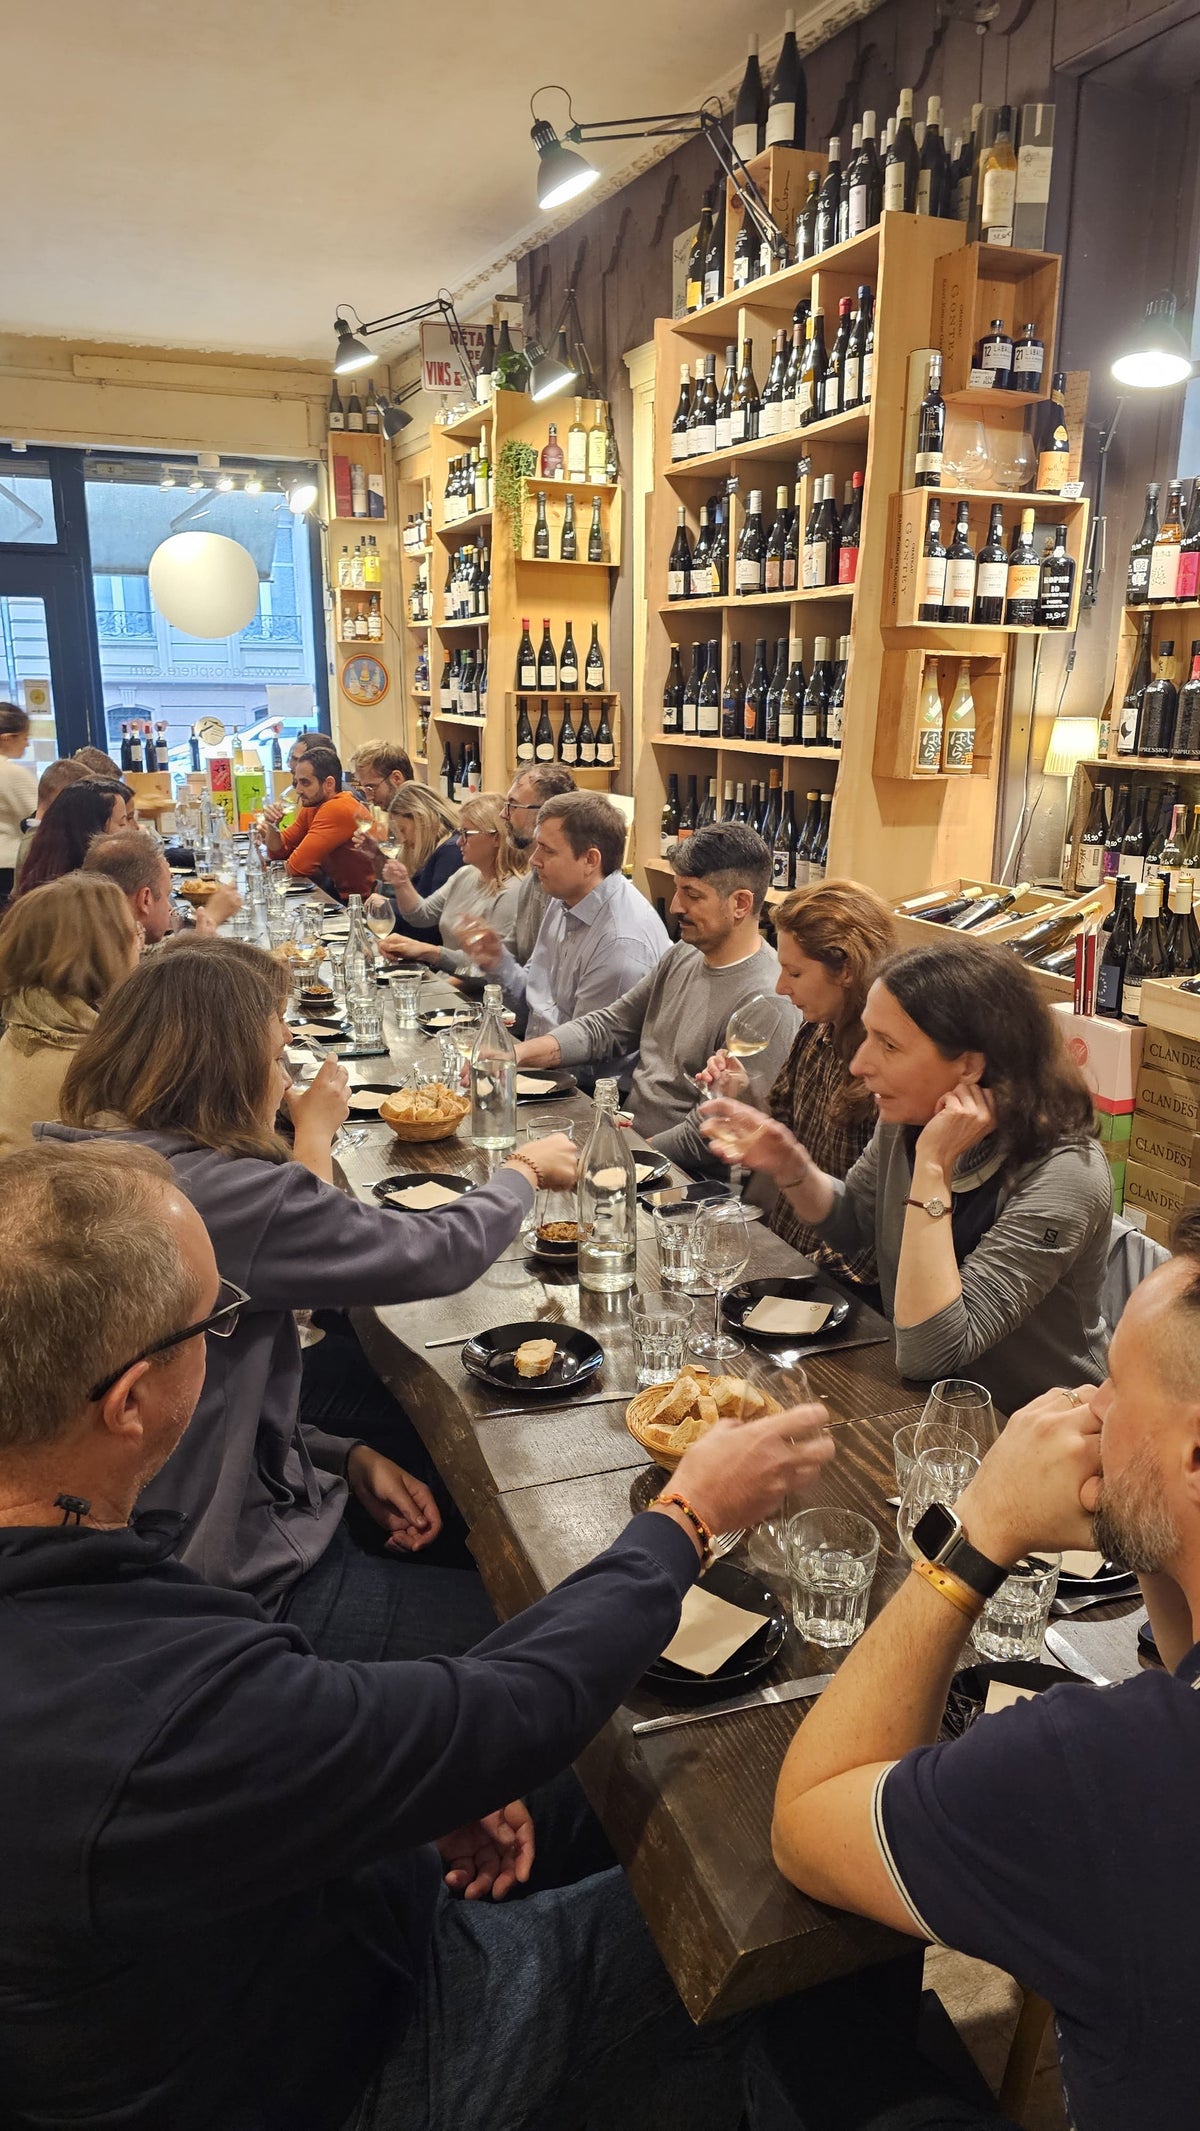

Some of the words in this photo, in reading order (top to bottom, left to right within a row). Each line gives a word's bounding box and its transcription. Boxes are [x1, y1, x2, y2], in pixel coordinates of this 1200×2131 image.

[426, 361, 451, 386] VINS
[901, 521, 912, 594] GONTEY
[1129, 1182, 1184, 1212] CLANDES
